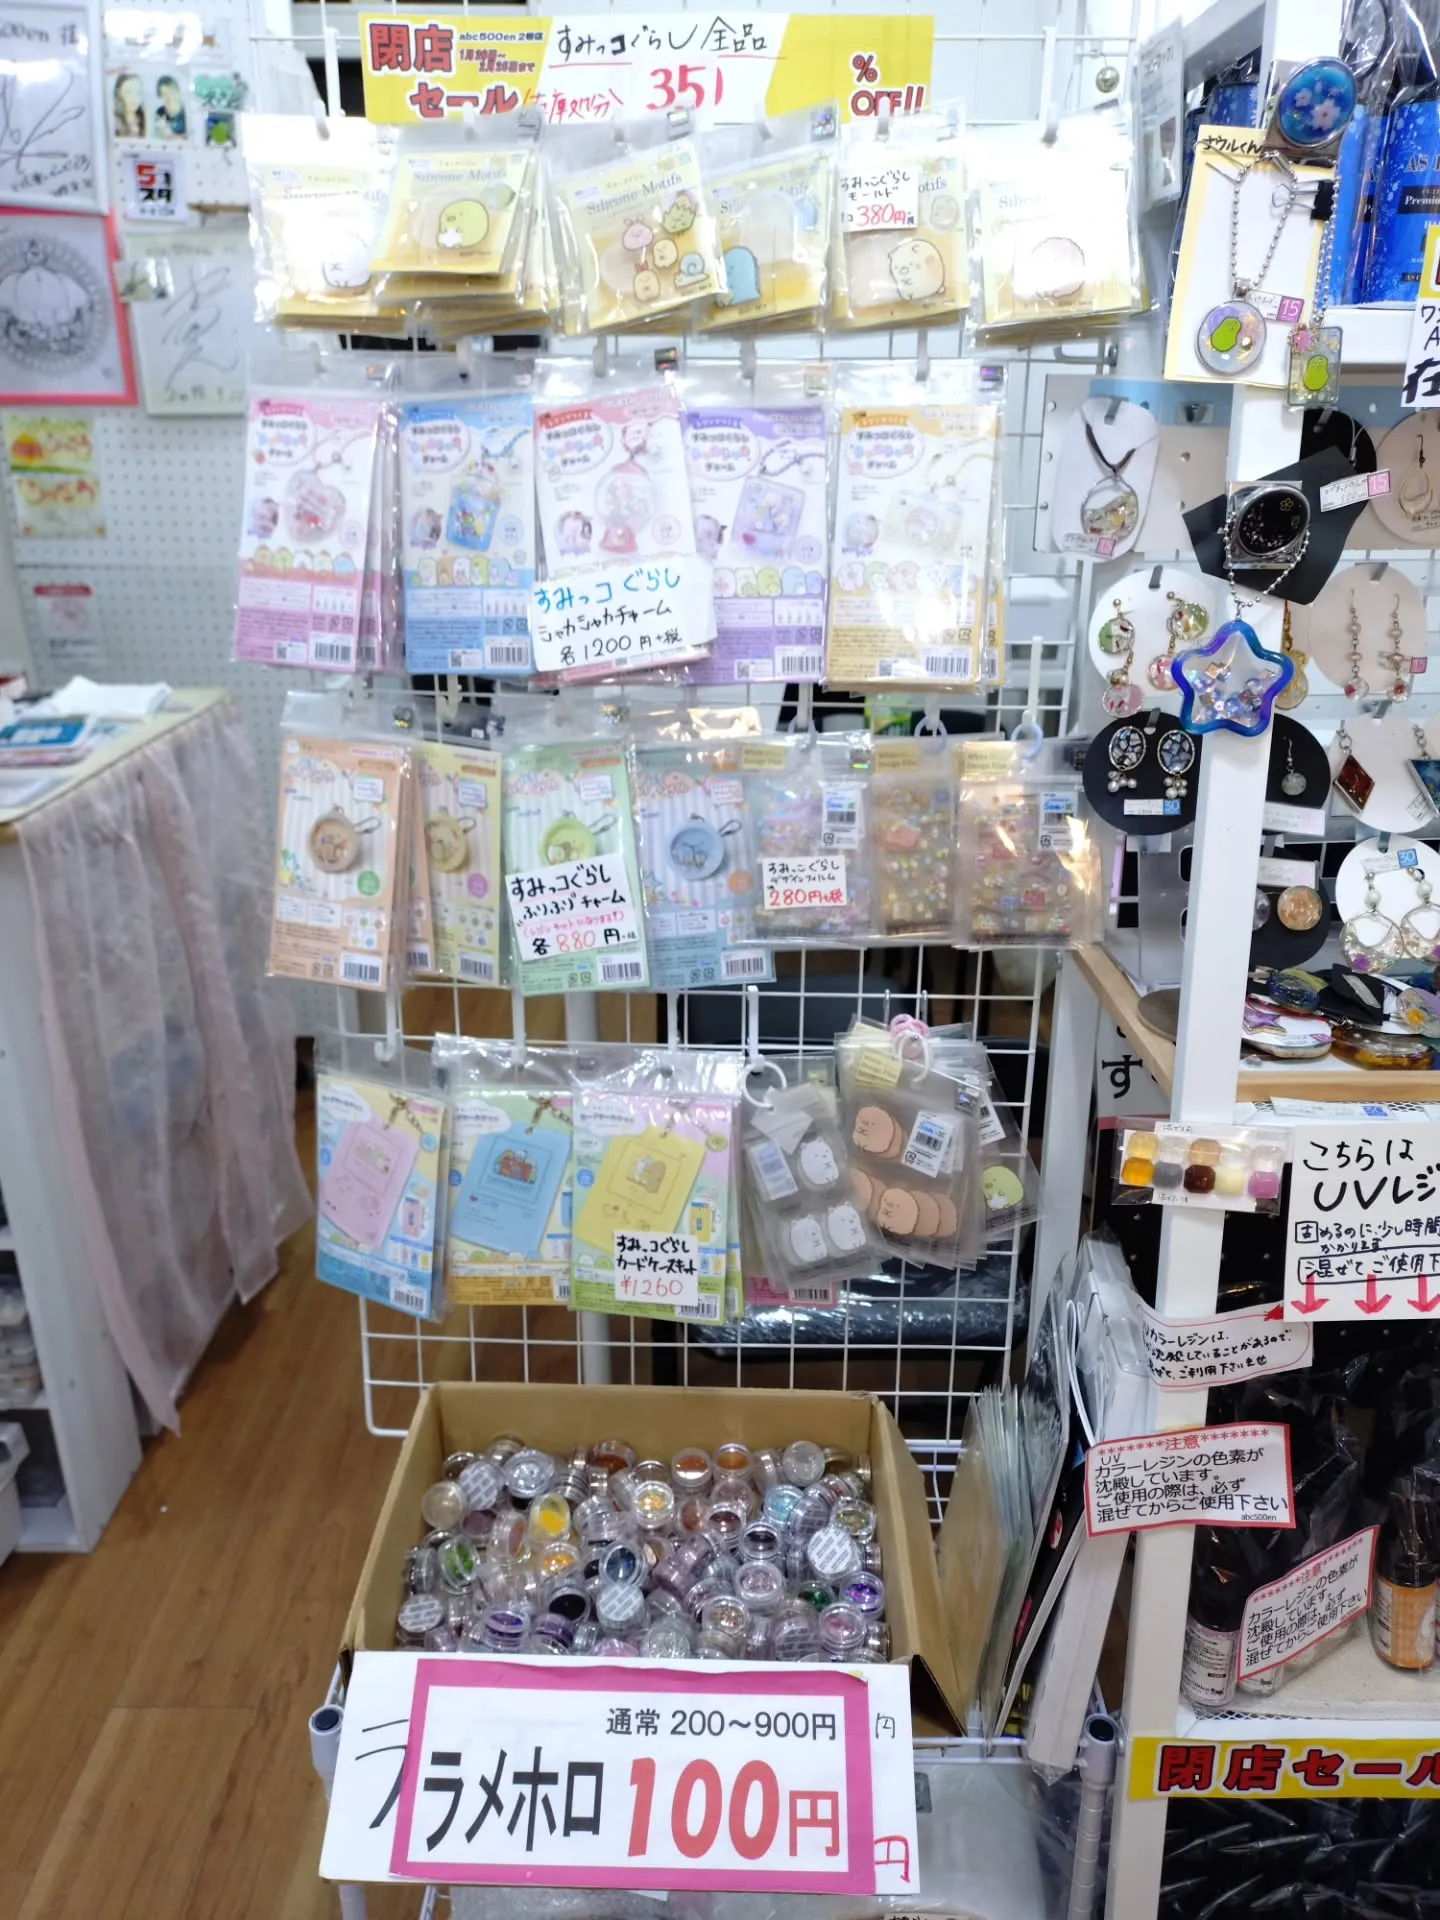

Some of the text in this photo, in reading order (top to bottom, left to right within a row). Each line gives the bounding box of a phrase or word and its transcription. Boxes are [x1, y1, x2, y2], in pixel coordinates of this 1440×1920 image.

[369, 23, 453, 72] 閉店
[459, 32, 516, 41] abc500en
[852, 54, 878, 82] %
[410, 82, 518, 119] セール
[511, 864, 612, 902] すみっコぐらし
[1303, 1138, 1415, 1172] こちらは
[620, 1274, 684, 1297] ¥1260
[1095, 1447, 1265, 1480] カラーレジンの色素が
[1101, 1453, 1121, 1465] UV
[1095, 1468, 1221, 1494] 沈殿しています。
[1097, 1478, 1246, 1508] ご使用の際は、必ず
[1097, 1494, 1288, 1524] 混ぜてからご使用下さい
[1241, 1512, 1277, 1522] abc500en
[1249, 1554, 1360, 1626] カラーレジンの色素が
[1245, 1589, 1368, 1668] 混ぜてからご使用下さい
[605, 1707, 839, 1742] 通常 200～900円
[1158, 1744, 1440, 1792] 閉店セール
[422, 1746, 841, 1861] ラメホロ 100円
